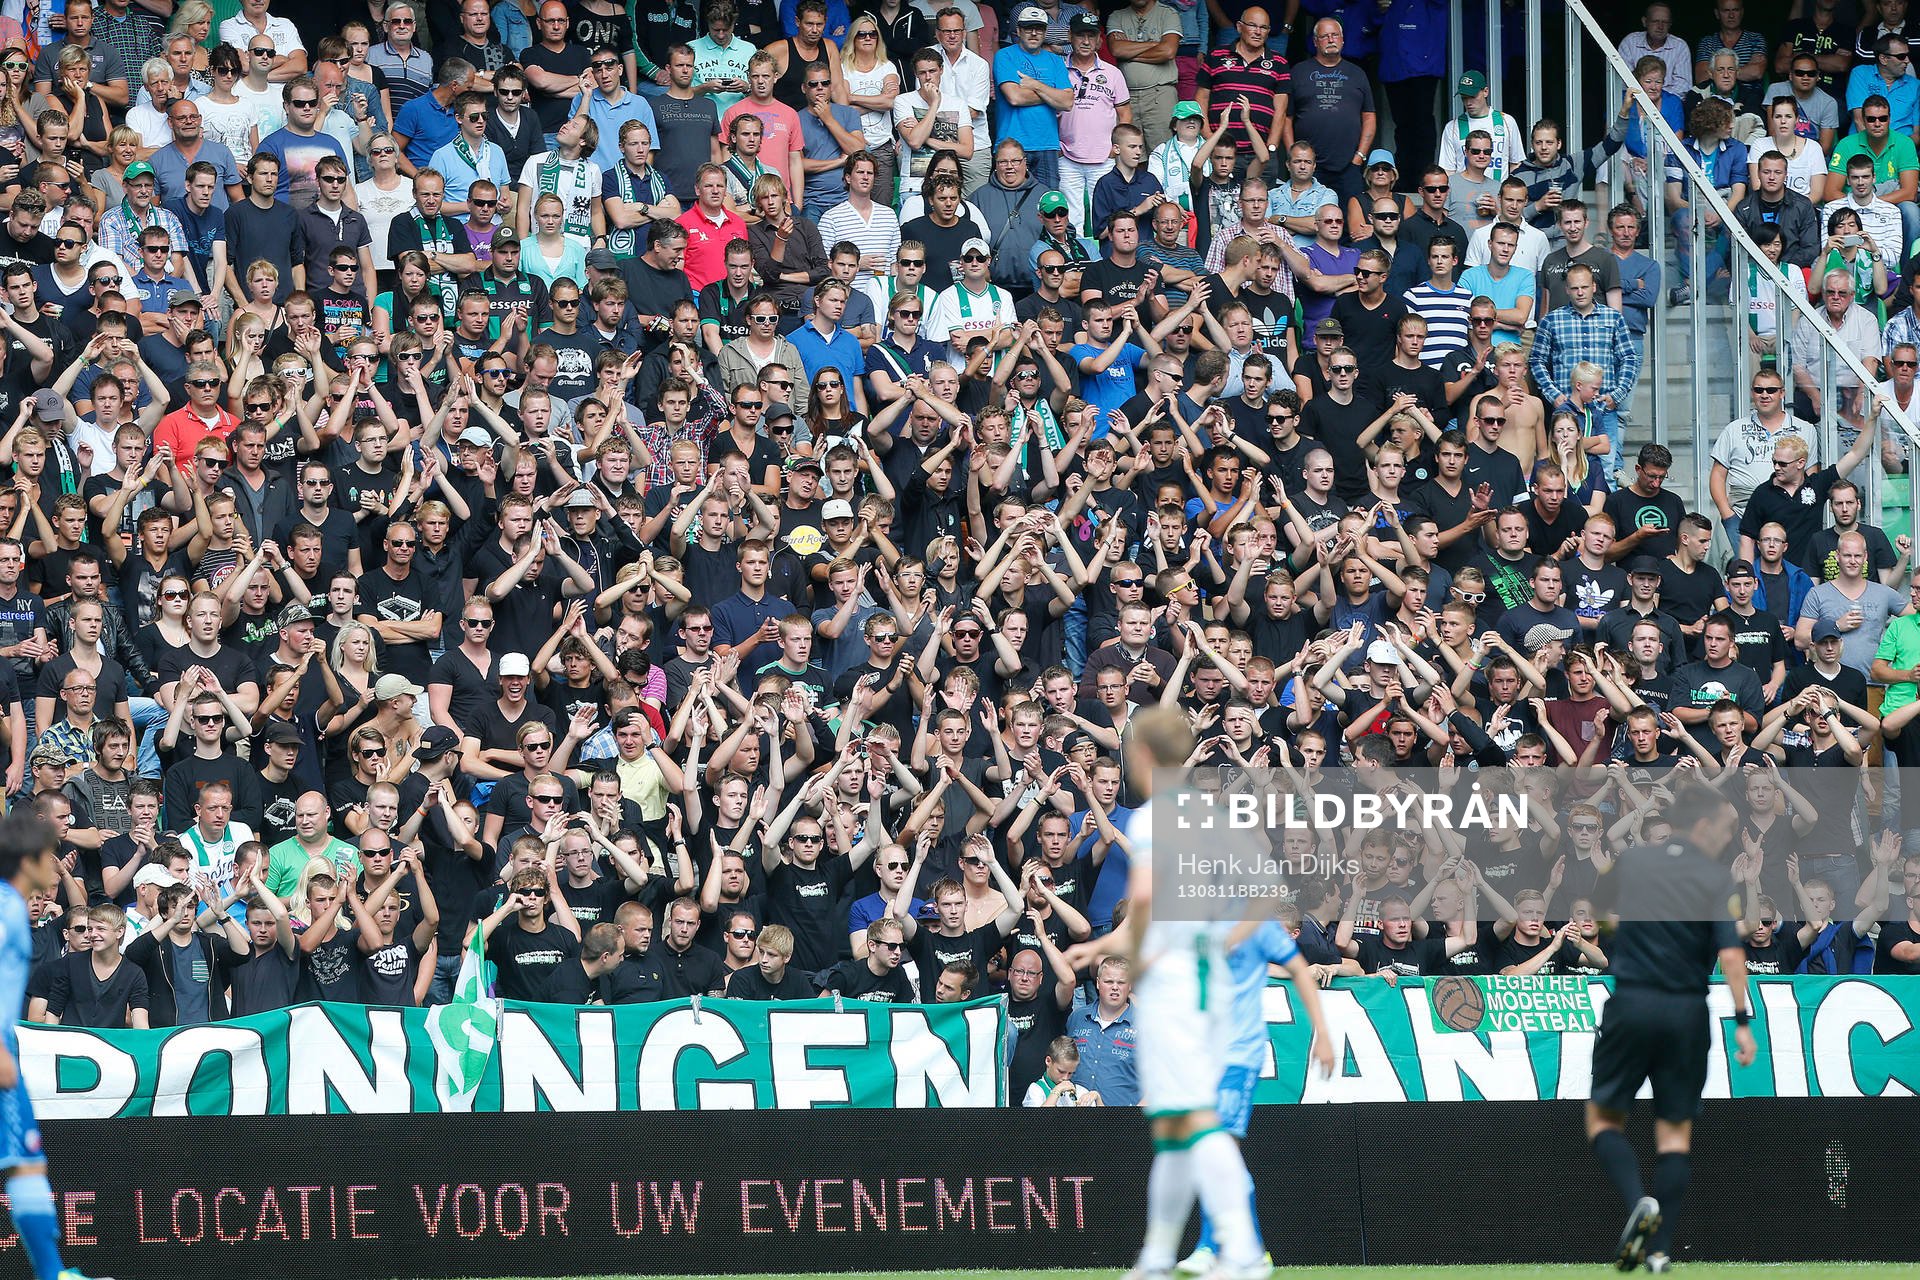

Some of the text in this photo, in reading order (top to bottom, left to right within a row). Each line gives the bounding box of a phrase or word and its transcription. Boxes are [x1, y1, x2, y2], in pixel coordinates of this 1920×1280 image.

[859, 80, 883, 89] PEAC
[1749, 301, 1776, 311] esse
[17, 599, 33, 611] NY
[1485, 975, 1584, 991] TEGEN HET
[1486, 991, 1592, 1012] MODERNE
[1488, 1011, 1595, 1032] VOETBAL
[133, 1185, 380, 1245] LOCATIE
[412, 1182, 571, 1240] VOOR
[610, 1180, 704, 1238] UW
[740, 1176, 1094, 1233] EVENEMENT
